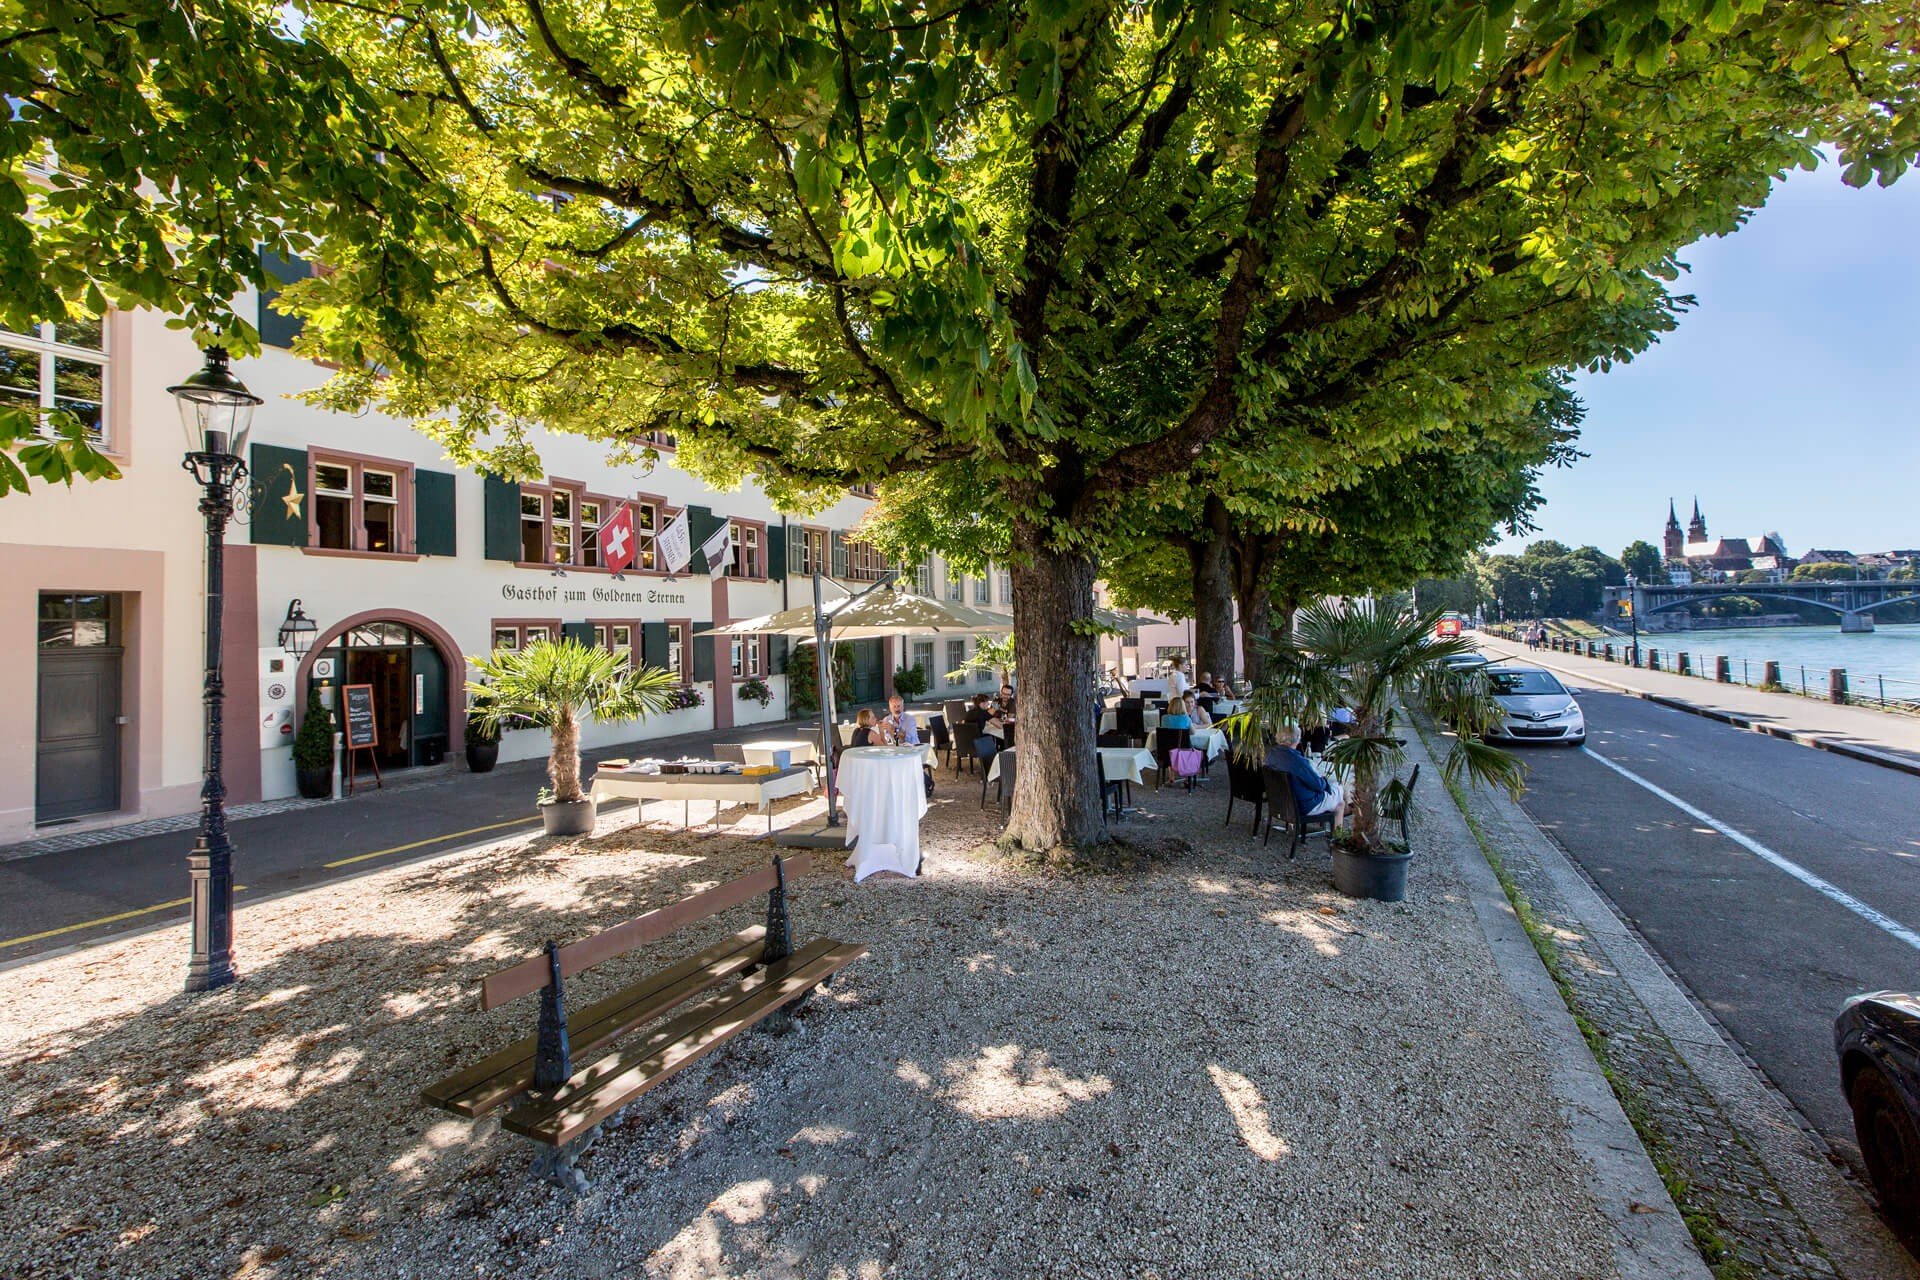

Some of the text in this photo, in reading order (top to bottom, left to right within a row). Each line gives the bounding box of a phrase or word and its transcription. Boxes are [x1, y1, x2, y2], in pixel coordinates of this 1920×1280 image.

[502, 584, 685, 604] Gasthof zum Goldenen Sternen
